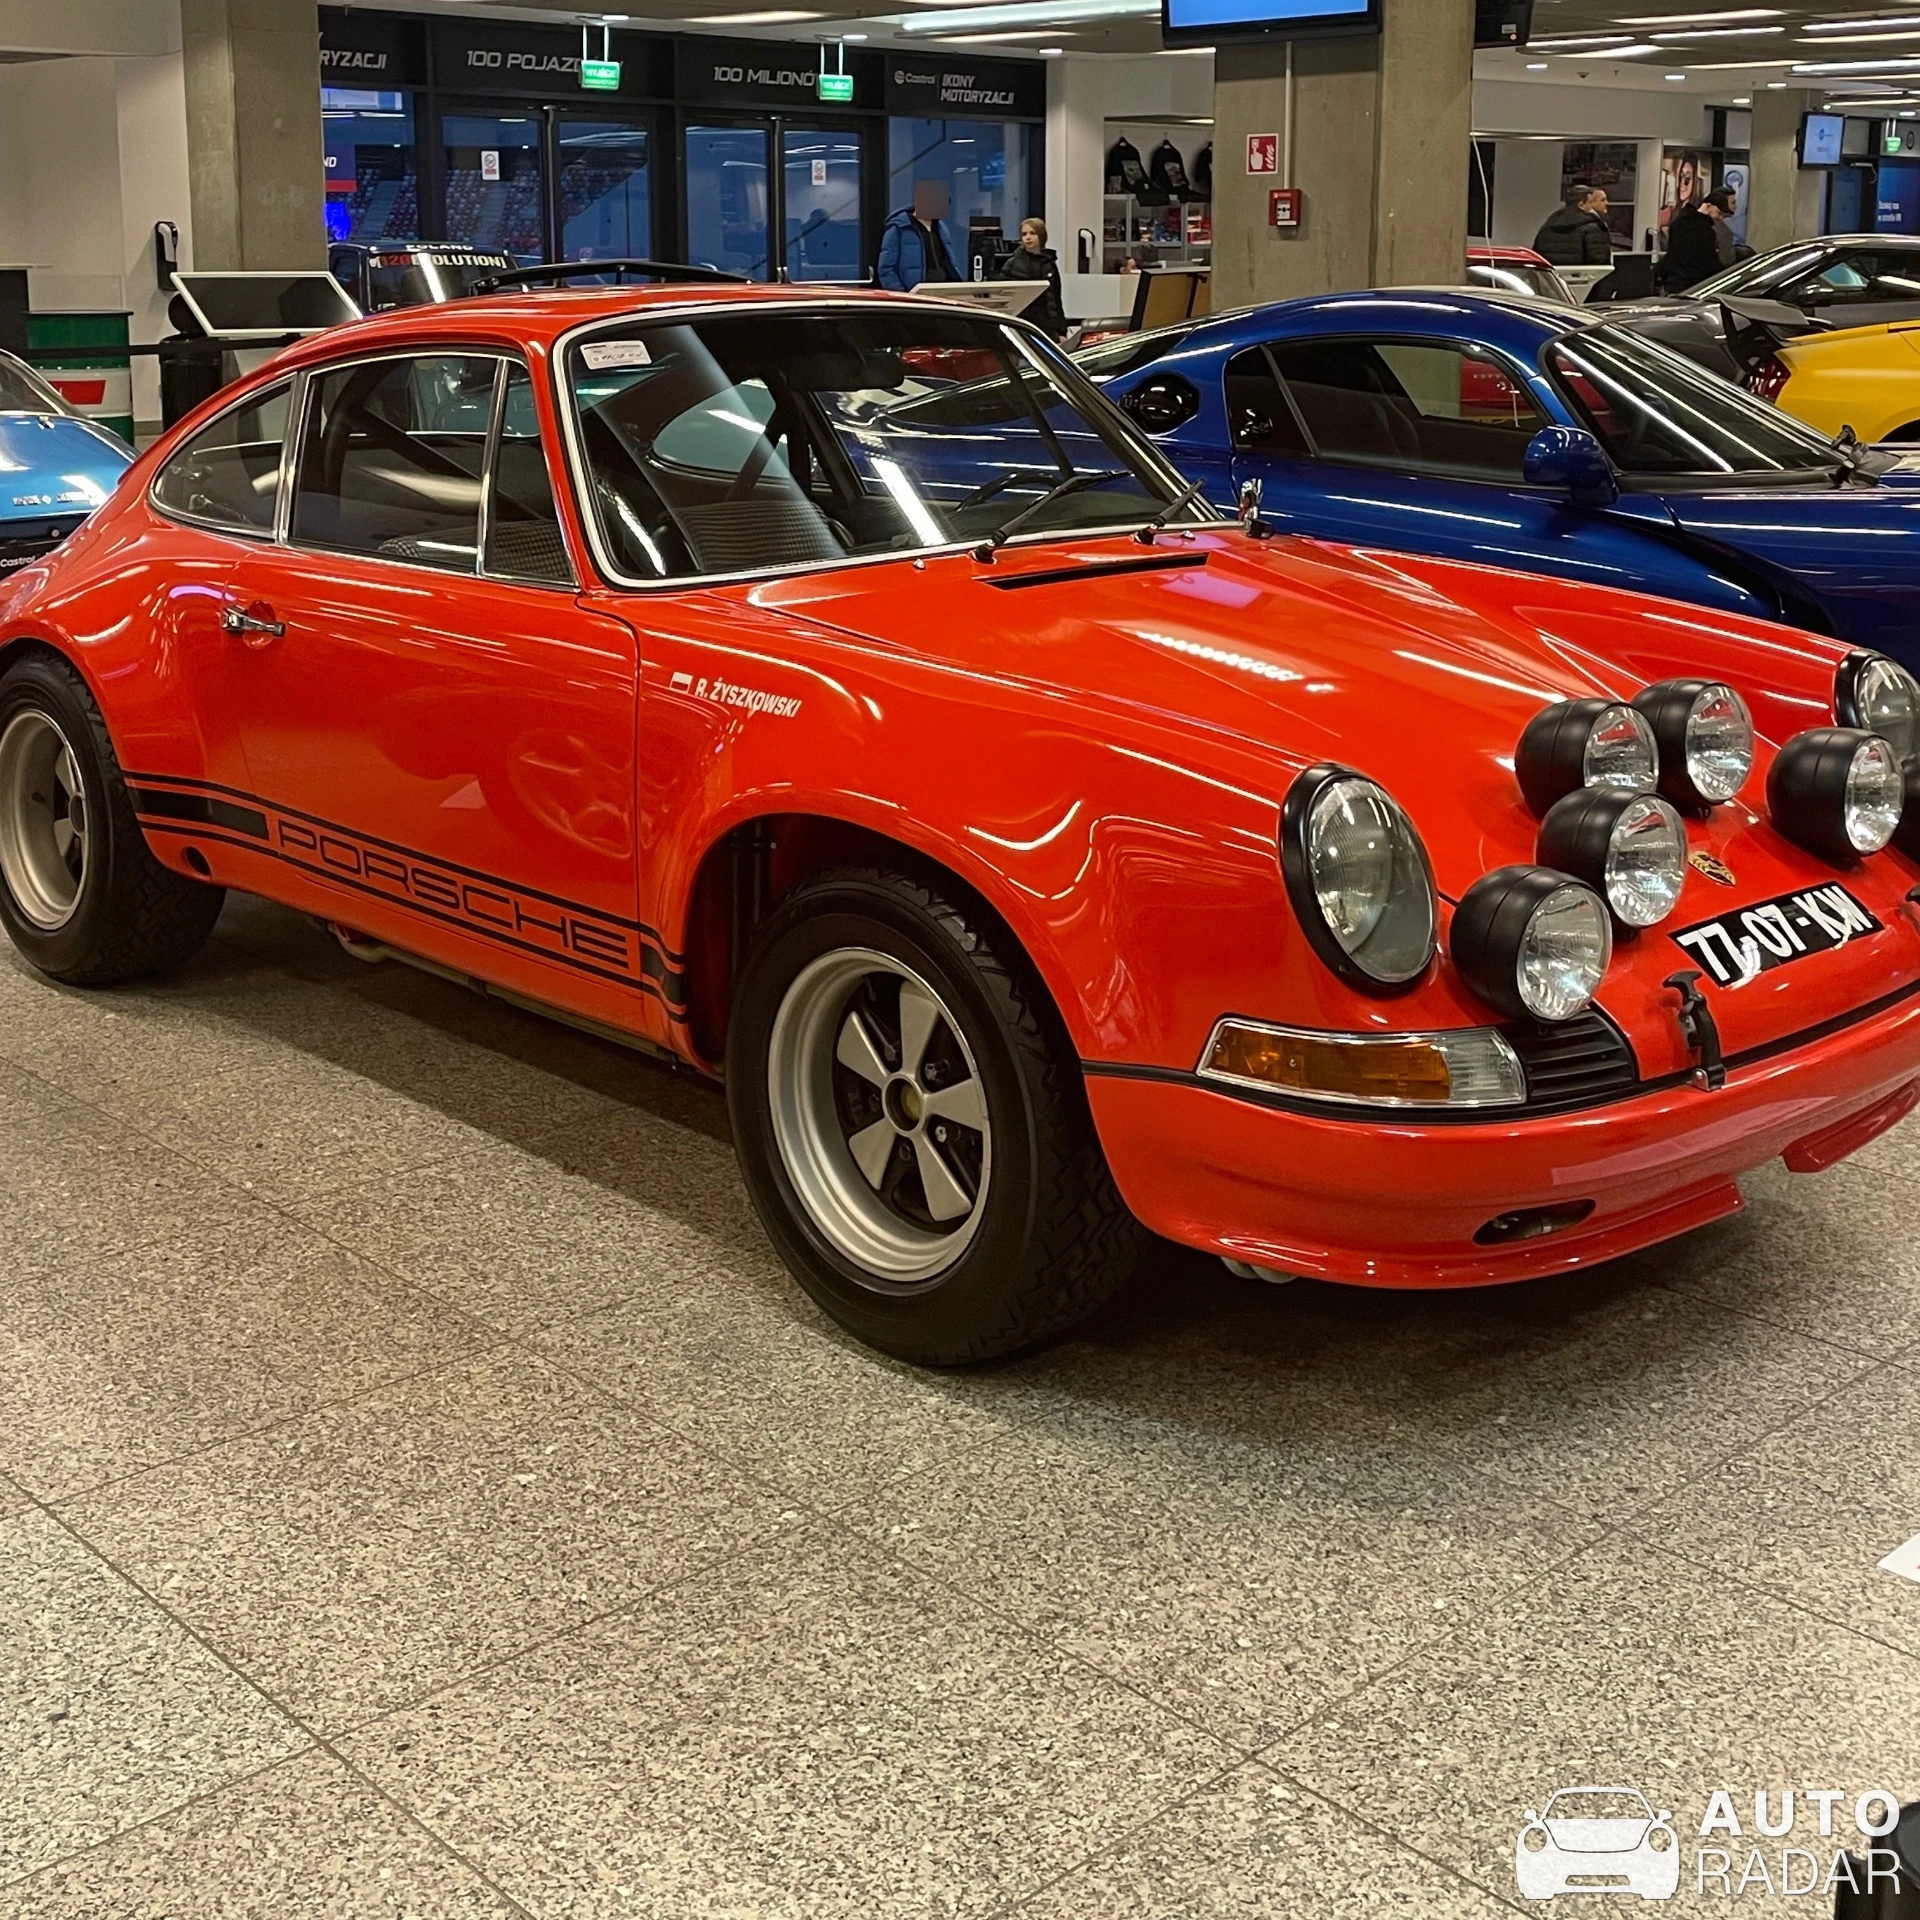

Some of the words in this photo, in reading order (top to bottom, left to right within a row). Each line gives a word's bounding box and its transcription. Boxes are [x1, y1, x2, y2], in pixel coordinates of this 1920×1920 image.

[467, 50, 501, 67] 100
[506, 53, 583, 73] POJAZD
[713, 66, 743, 82] 100
[747, 69, 816, 87] MILIONÓ
[905, 73, 936, 84] Castrol
[942, 73, 975, 88] IKONY
[940, 88, 1015, 105] MOTORYZACJI
[0, 555, 36, 568] Castrol
[694, 677, 709, 699] R.
[708, 676, 802, 718] ŻYSZKOWSKI
[278, 818, 630, 970] PORSCHE
